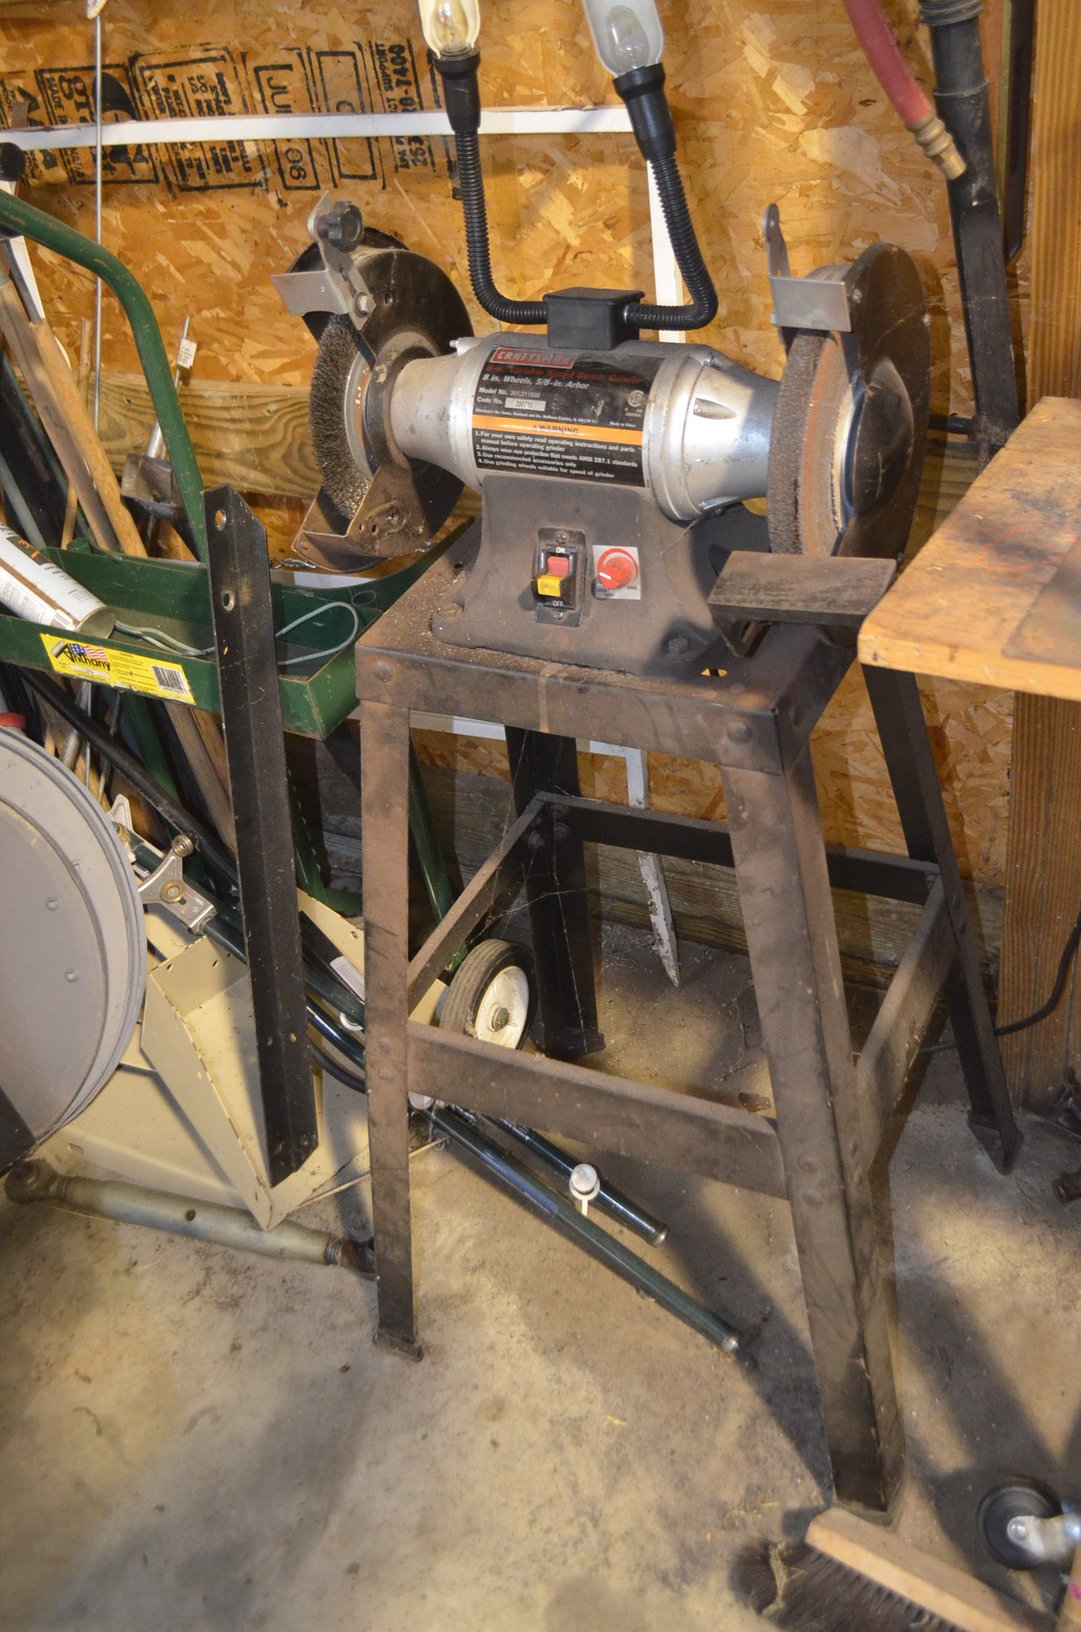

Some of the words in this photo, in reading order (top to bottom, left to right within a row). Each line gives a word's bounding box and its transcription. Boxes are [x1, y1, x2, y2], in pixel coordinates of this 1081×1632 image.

[375, 42, 394, 92] SUPPORT
[497, 350, 573, 365] CRAFTSMAN
[482, 373, 490, 381] 8
[503, 375, 533, 385] Wheels,
[565, 380, 590, 390] Arbor
[479, 387, 497, 395] Model
[539, 424, 579, 434] WARNING
[517, 434, 534, 442] safety
[548, 438, 574, 447] operating
[574, 441, 607, 450] instructions
[519, 441, 545, 450] operating
[545, 444, 565, 452] grinder
[494, 454, 532, 462] recommended
[532, 457, 564, 466] accessories
[524, 449, 550, 458] protection
[578, 455, 593, 463] ANSI
[611, 459, 639, 467] standards
[61, 642, 111, 672] Anthony
